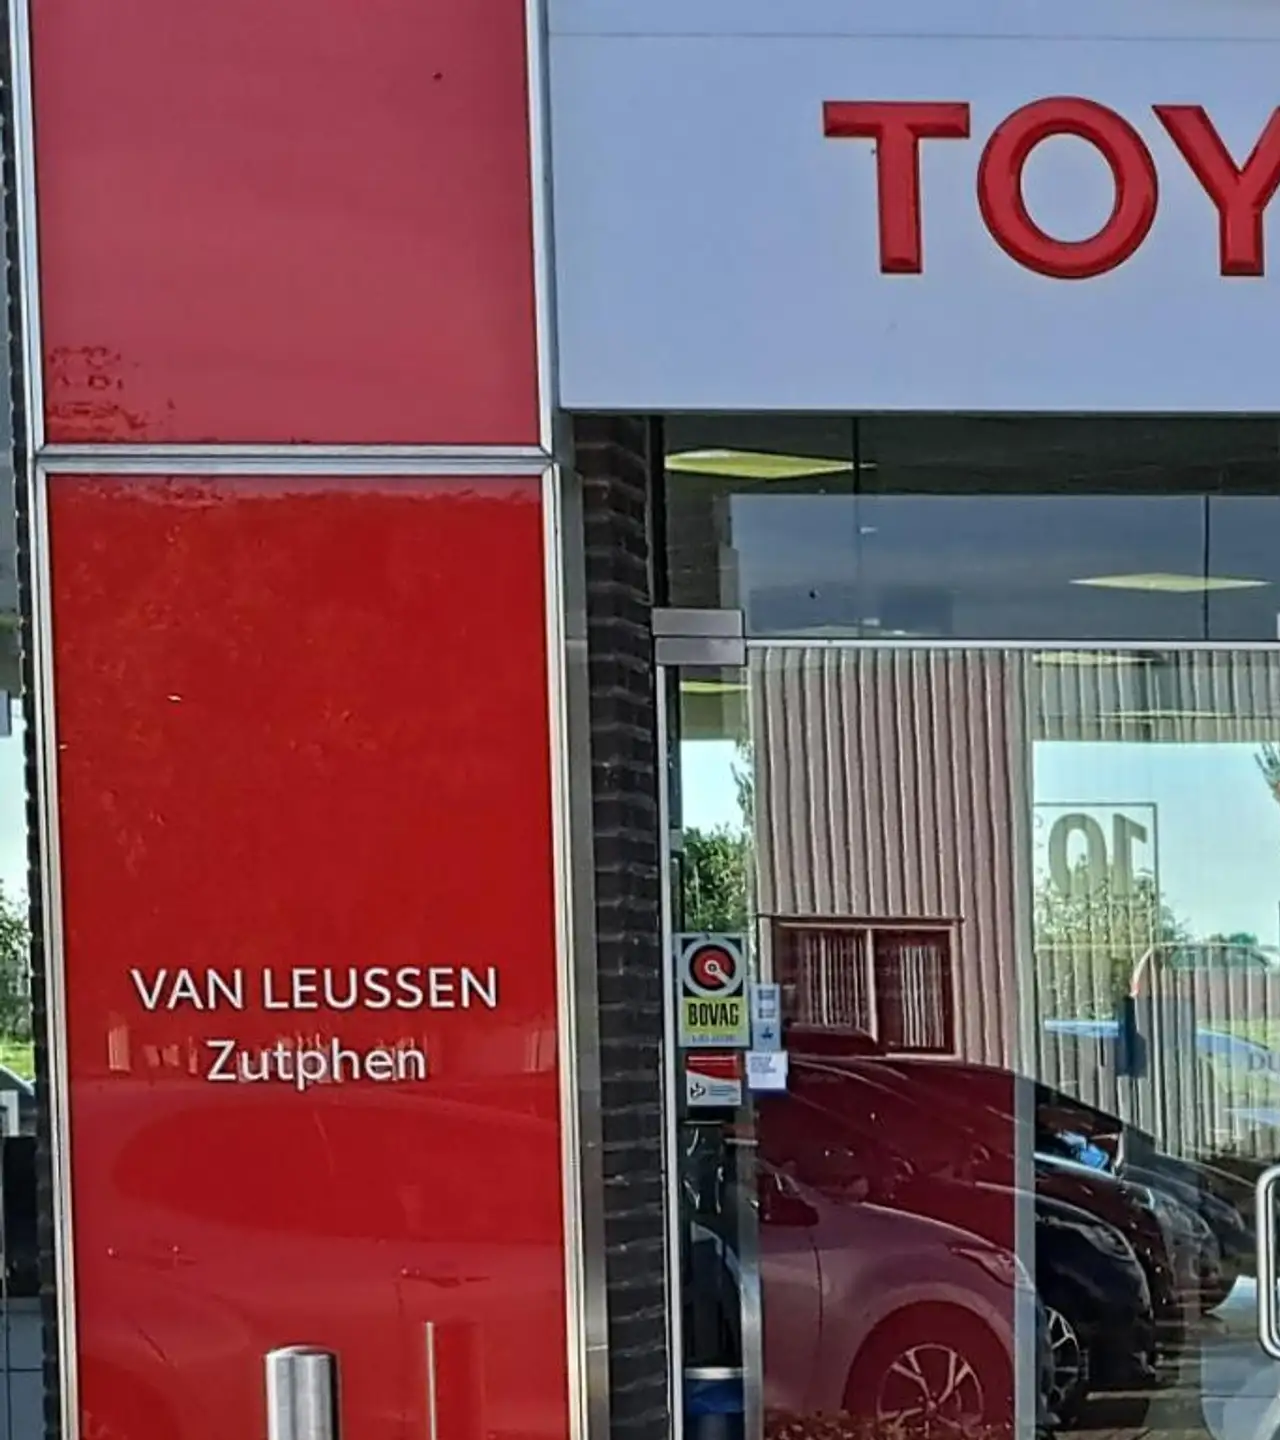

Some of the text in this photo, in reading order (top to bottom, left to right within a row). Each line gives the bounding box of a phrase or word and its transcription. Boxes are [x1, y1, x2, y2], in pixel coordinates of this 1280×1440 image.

[130, 967, 497, 1010] VAN LEUSSEN
[687, 1002, 739, 1026] BOVAG
[205, 1035, 427, 1090] Zutphen
